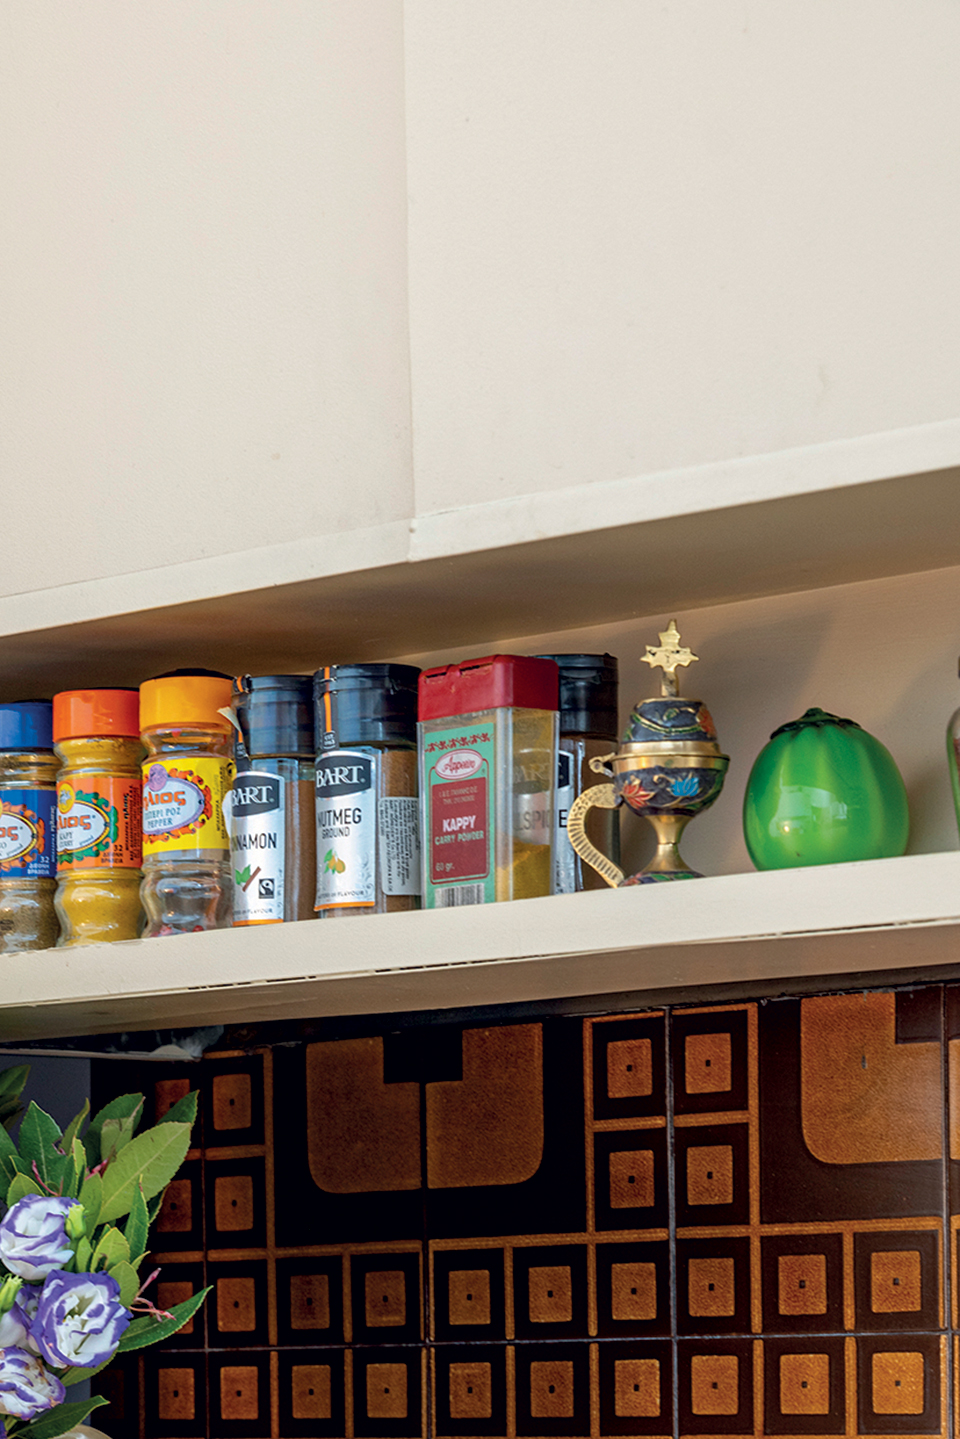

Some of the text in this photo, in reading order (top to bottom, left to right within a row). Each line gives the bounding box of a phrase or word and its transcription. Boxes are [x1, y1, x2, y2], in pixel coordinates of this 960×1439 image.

[316, 766, 365, 788] BART
[318, 808, 362, 828] NUTMEG
[322, 826, 351, 839] GROUND
